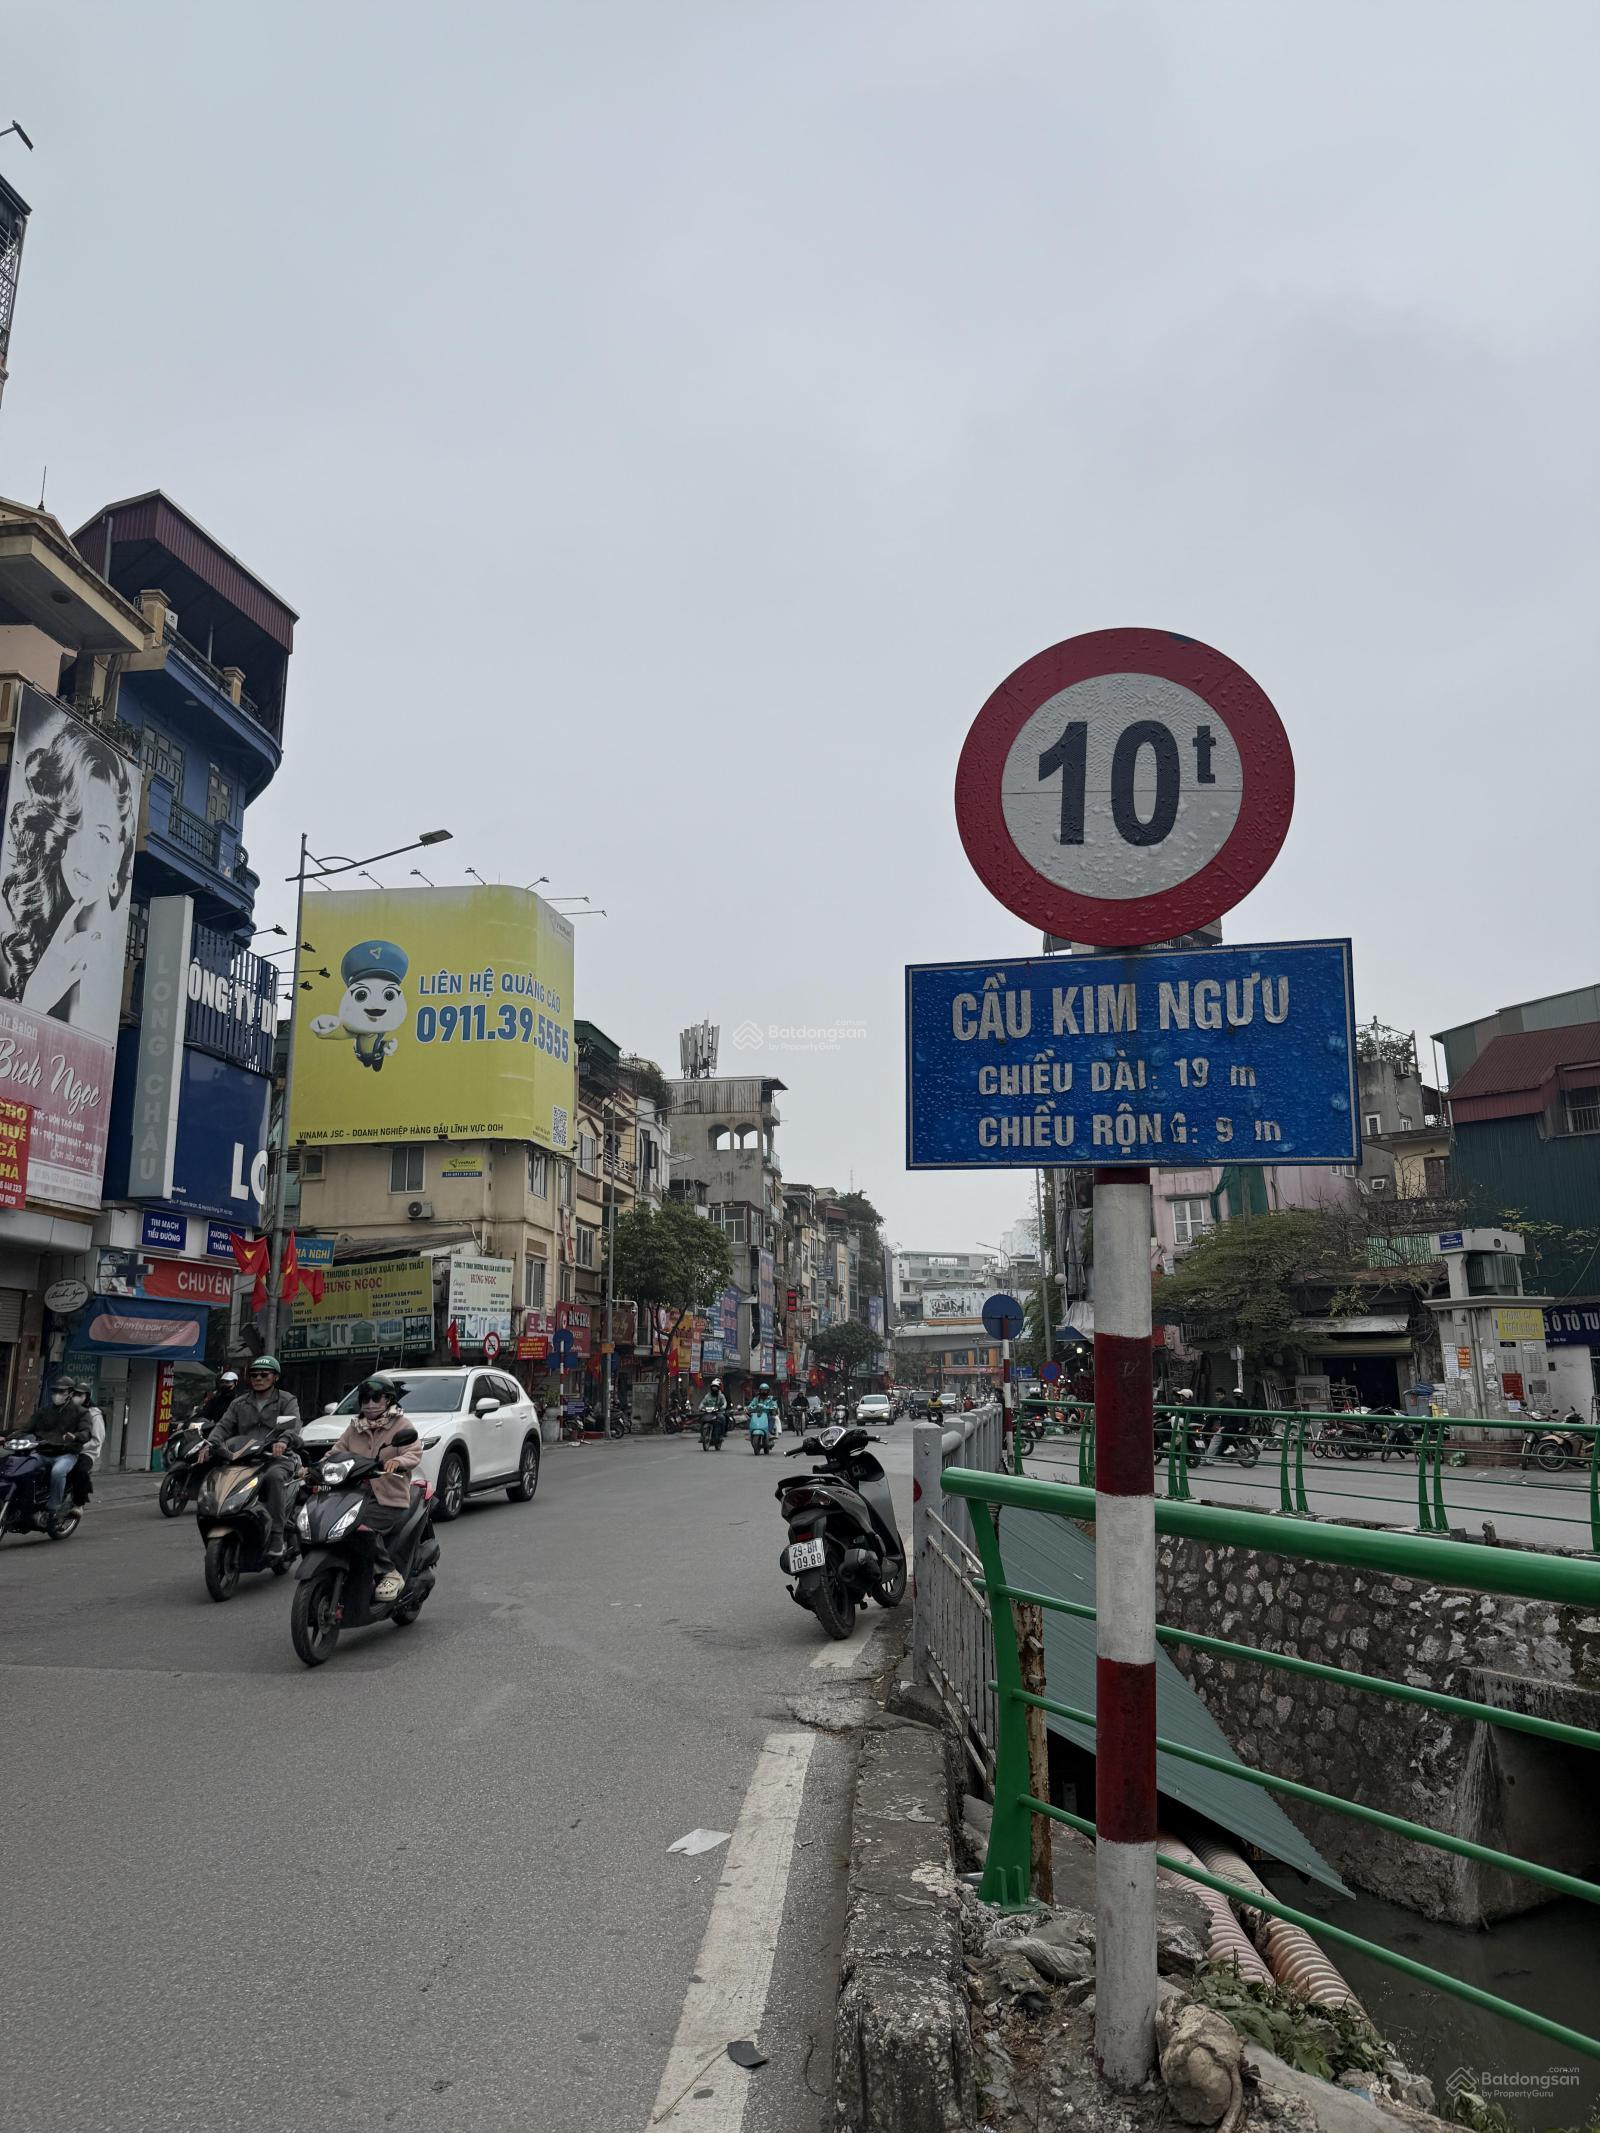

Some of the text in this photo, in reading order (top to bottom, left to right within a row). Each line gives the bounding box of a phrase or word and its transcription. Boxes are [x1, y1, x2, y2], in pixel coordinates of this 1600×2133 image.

[186, 956, 228, 1015] ÔNG
[234, 985, 257, 1027] TY
[419, 967, 561, 1014] LIÊN HỆ QUẢNG CÁO
[951, 971, 1291, 1042] CẦU KIM NGƯU
[0, 1012, 39, 1040] air Salon
[416, 1004, 569, 1064] 0911.39.5555
[0, 1038, 102, 1116] Bích Ngọc
[139, 953, 169, 1181] LONG CHÂU
[978, 1049, 1257, 1095] CHIỀU DÀI: 19 m
[0, 1122, 27, 1142] HUÊ
[299, 1130, 328, 1140] VINAMA
[330, 1130, 344, 1139] JSC
[352, 1129, 379, 1138] DOANH
[380, 1125, 408, 1138] NGHIỆP
[410, 1124, 431, 1135] HÀNG
[433, 1122, 448, 1134] ĐẦU
[450, 1123, 468, 1133] LĨNH
[470, 1123, 485, 1135] VỰC
[487, 1124, 504, 1132] OOH
[978, 1100, 1282, 1155] CHIỀU RỘNG: 9 m
[0, 1163, 19, 1181] HÀ
[230, 1142, 268, 1206] LO
[151, 1218, 179, 1231] TIM MẠCH
[295, 1247, 306, 1258] HÀ
[177, 1271, 230, 1298] CHUYÊN
[354, 1277, 382, 1292] NGỌC
[1551, 1311, 1562, 1332] Ô
[1562, 1310, 1581, 1331] TÔ
[1582, 1311, 1600, 1330] TU
[792, 1553, 822, 1571] 109.88
